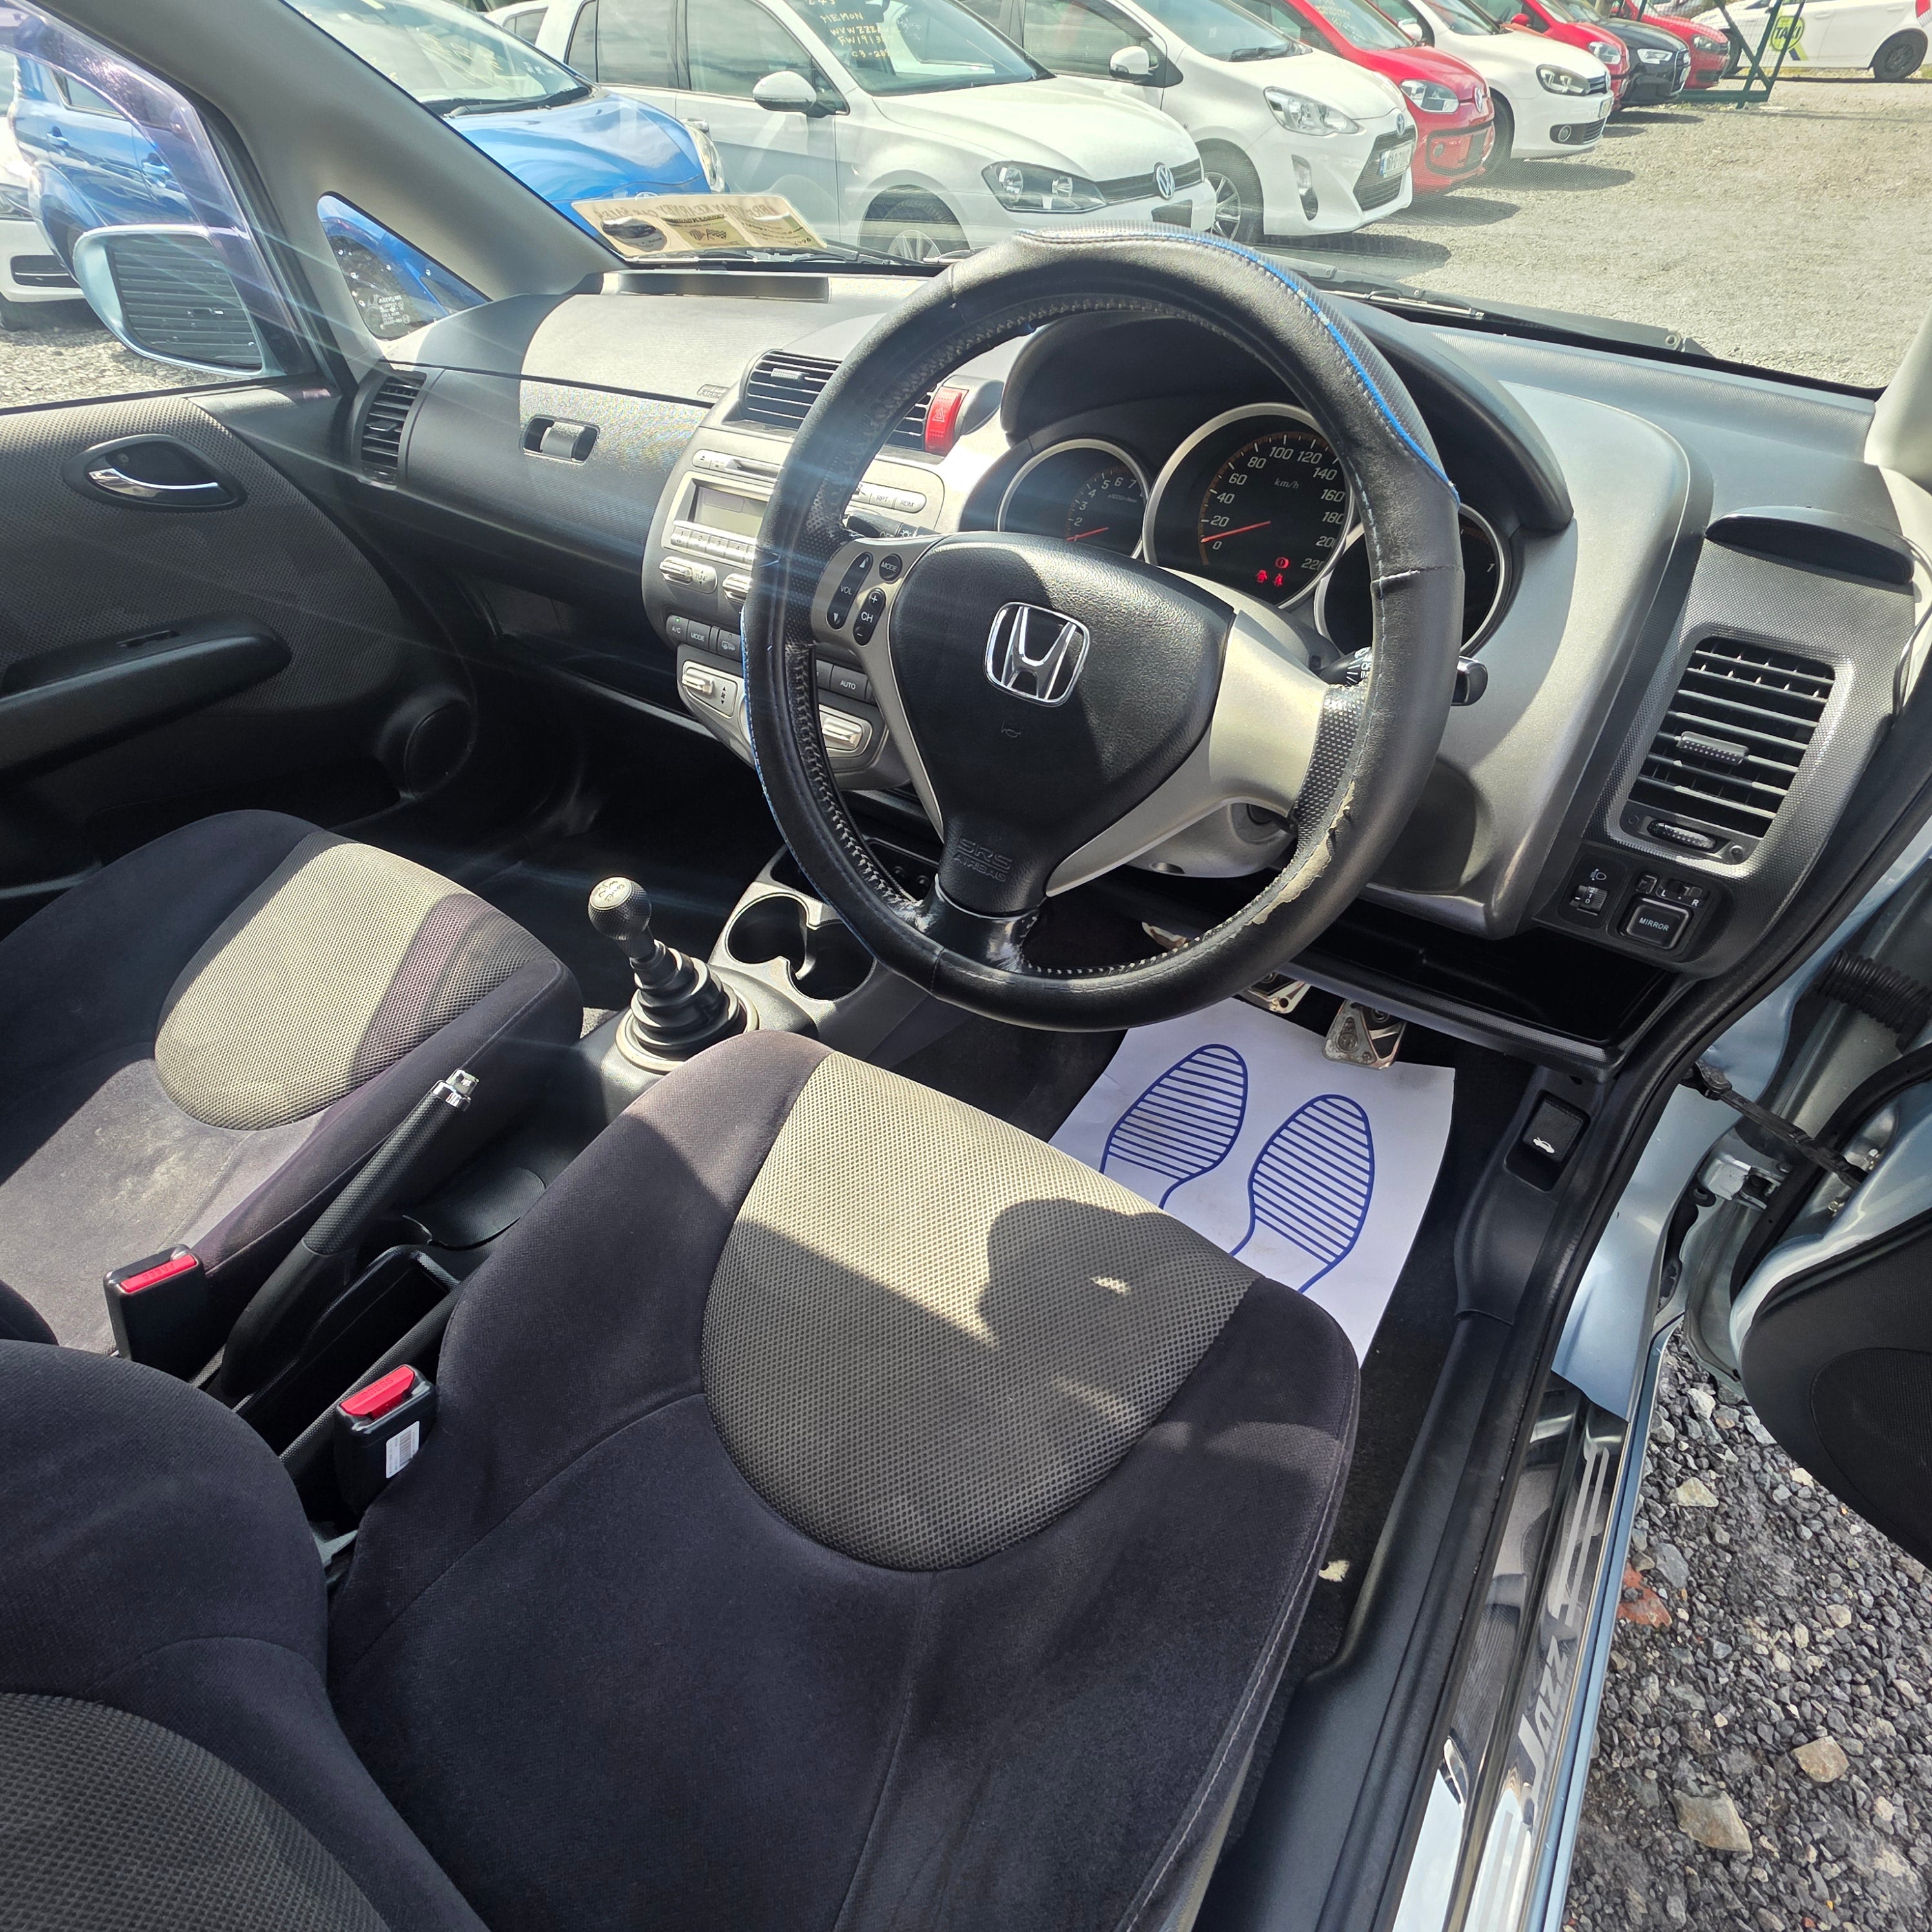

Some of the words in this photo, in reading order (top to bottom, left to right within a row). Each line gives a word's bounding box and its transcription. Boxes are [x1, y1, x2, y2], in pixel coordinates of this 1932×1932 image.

[1775, 26, 1802, 39] TAI
[1269, 446, 1294, 460] 100
[1297, 451, 1322, 464] 120
[1247, 457, 1267, 469] 80
[1228, 473, 1248, 485] 60
[1313, 467, 1337, 480] 140
[1101, 479, 1111, 489] 5
[1114, 477, 1124, 486] 6
[1128, 479, 1136, 488] 7
[1274, 478, 1299, 489] km/h
[1088, 489, 1097, 498] 4
[1217, 492, 1235, 504] 40
[1321, 489, 1346, 502] 160
[1079, 501, 1088, 511] 3
[1074, 517, 1082, 526] 2
[1211, 515, 1229, 528] 20
[1322, 511, 1345, 524] 180
[1213, 541, 1222, 550] 0
[880, 561, 898, 572] MODE
[841, 585, 852, 595] VOL
[861, 611, 873, 623] CH
[690, 633, 705, 642] MODE
[1361, 662, 1372, 670] OF
[839, 680, 856, 690] AUTO
[957, 839, 1012, 870] SRS
[1639, 917, 1669, 931] MIRROR
[1517, 1635, 1568, 1805] Jazz
